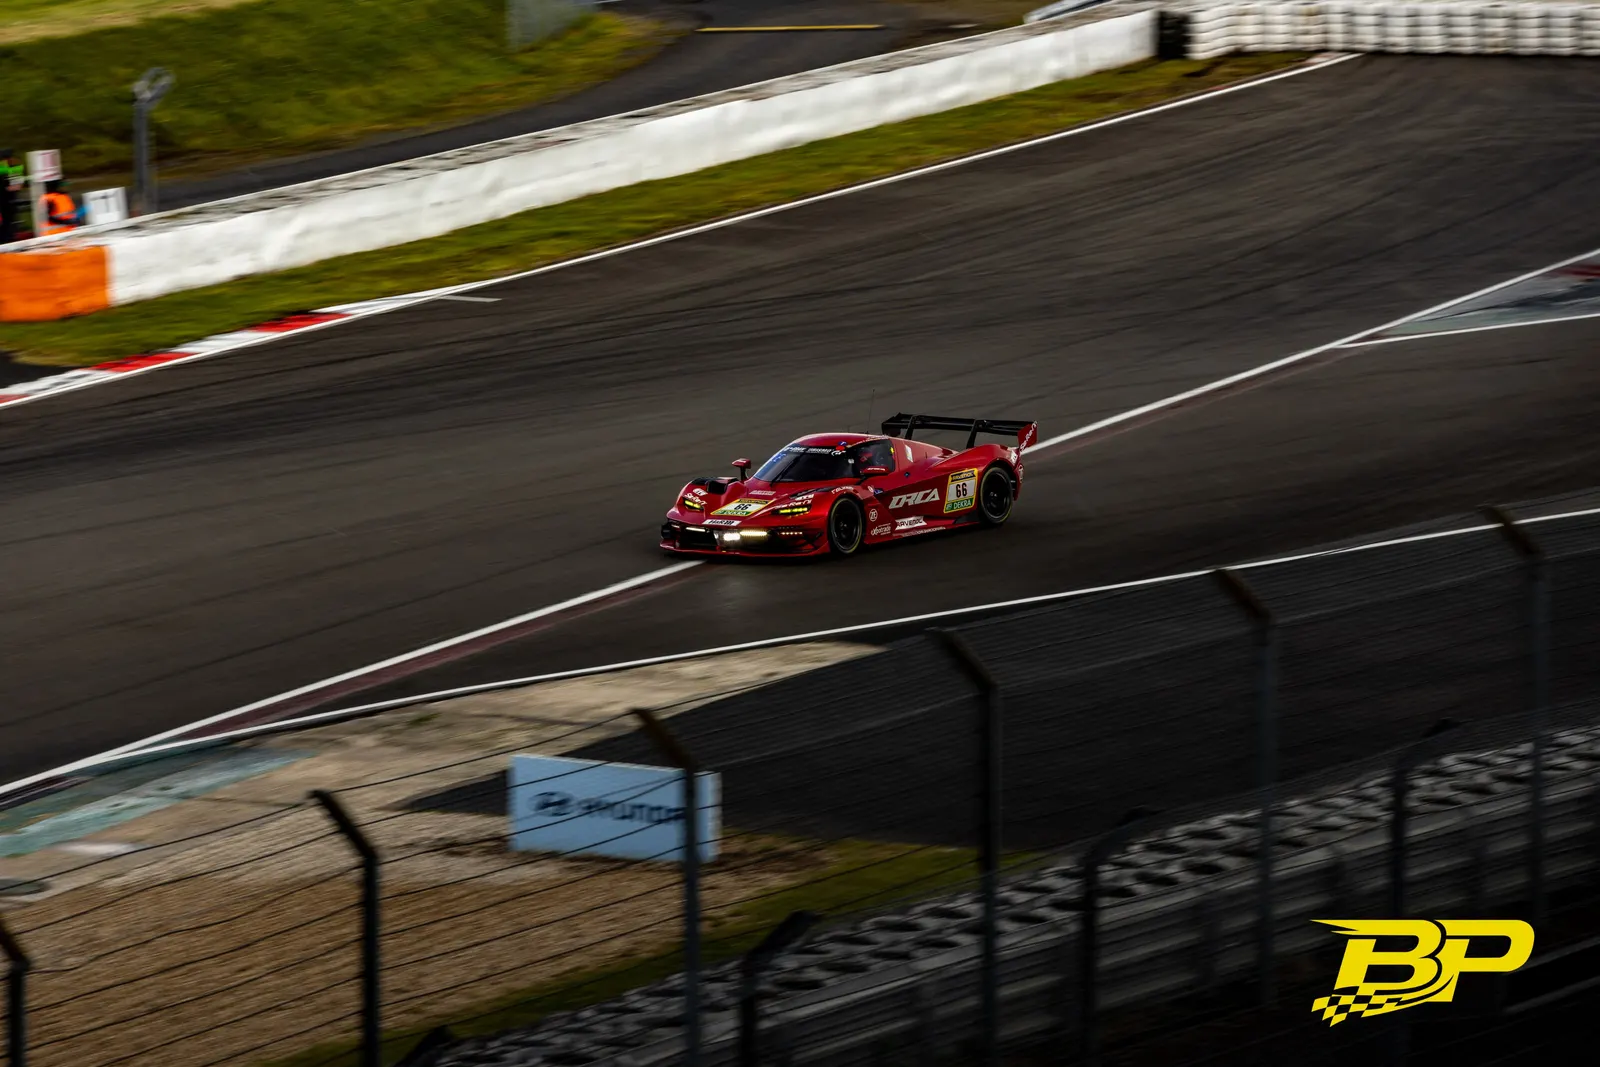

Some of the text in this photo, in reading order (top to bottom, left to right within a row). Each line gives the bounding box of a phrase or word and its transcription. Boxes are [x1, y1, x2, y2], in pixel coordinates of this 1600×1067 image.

[955, 482, 968, 498] 66
[888, 488, 940, 509] ORCA
[953, 499, 972, 510] DEKRA
[734, 503, 752, 511] 66
